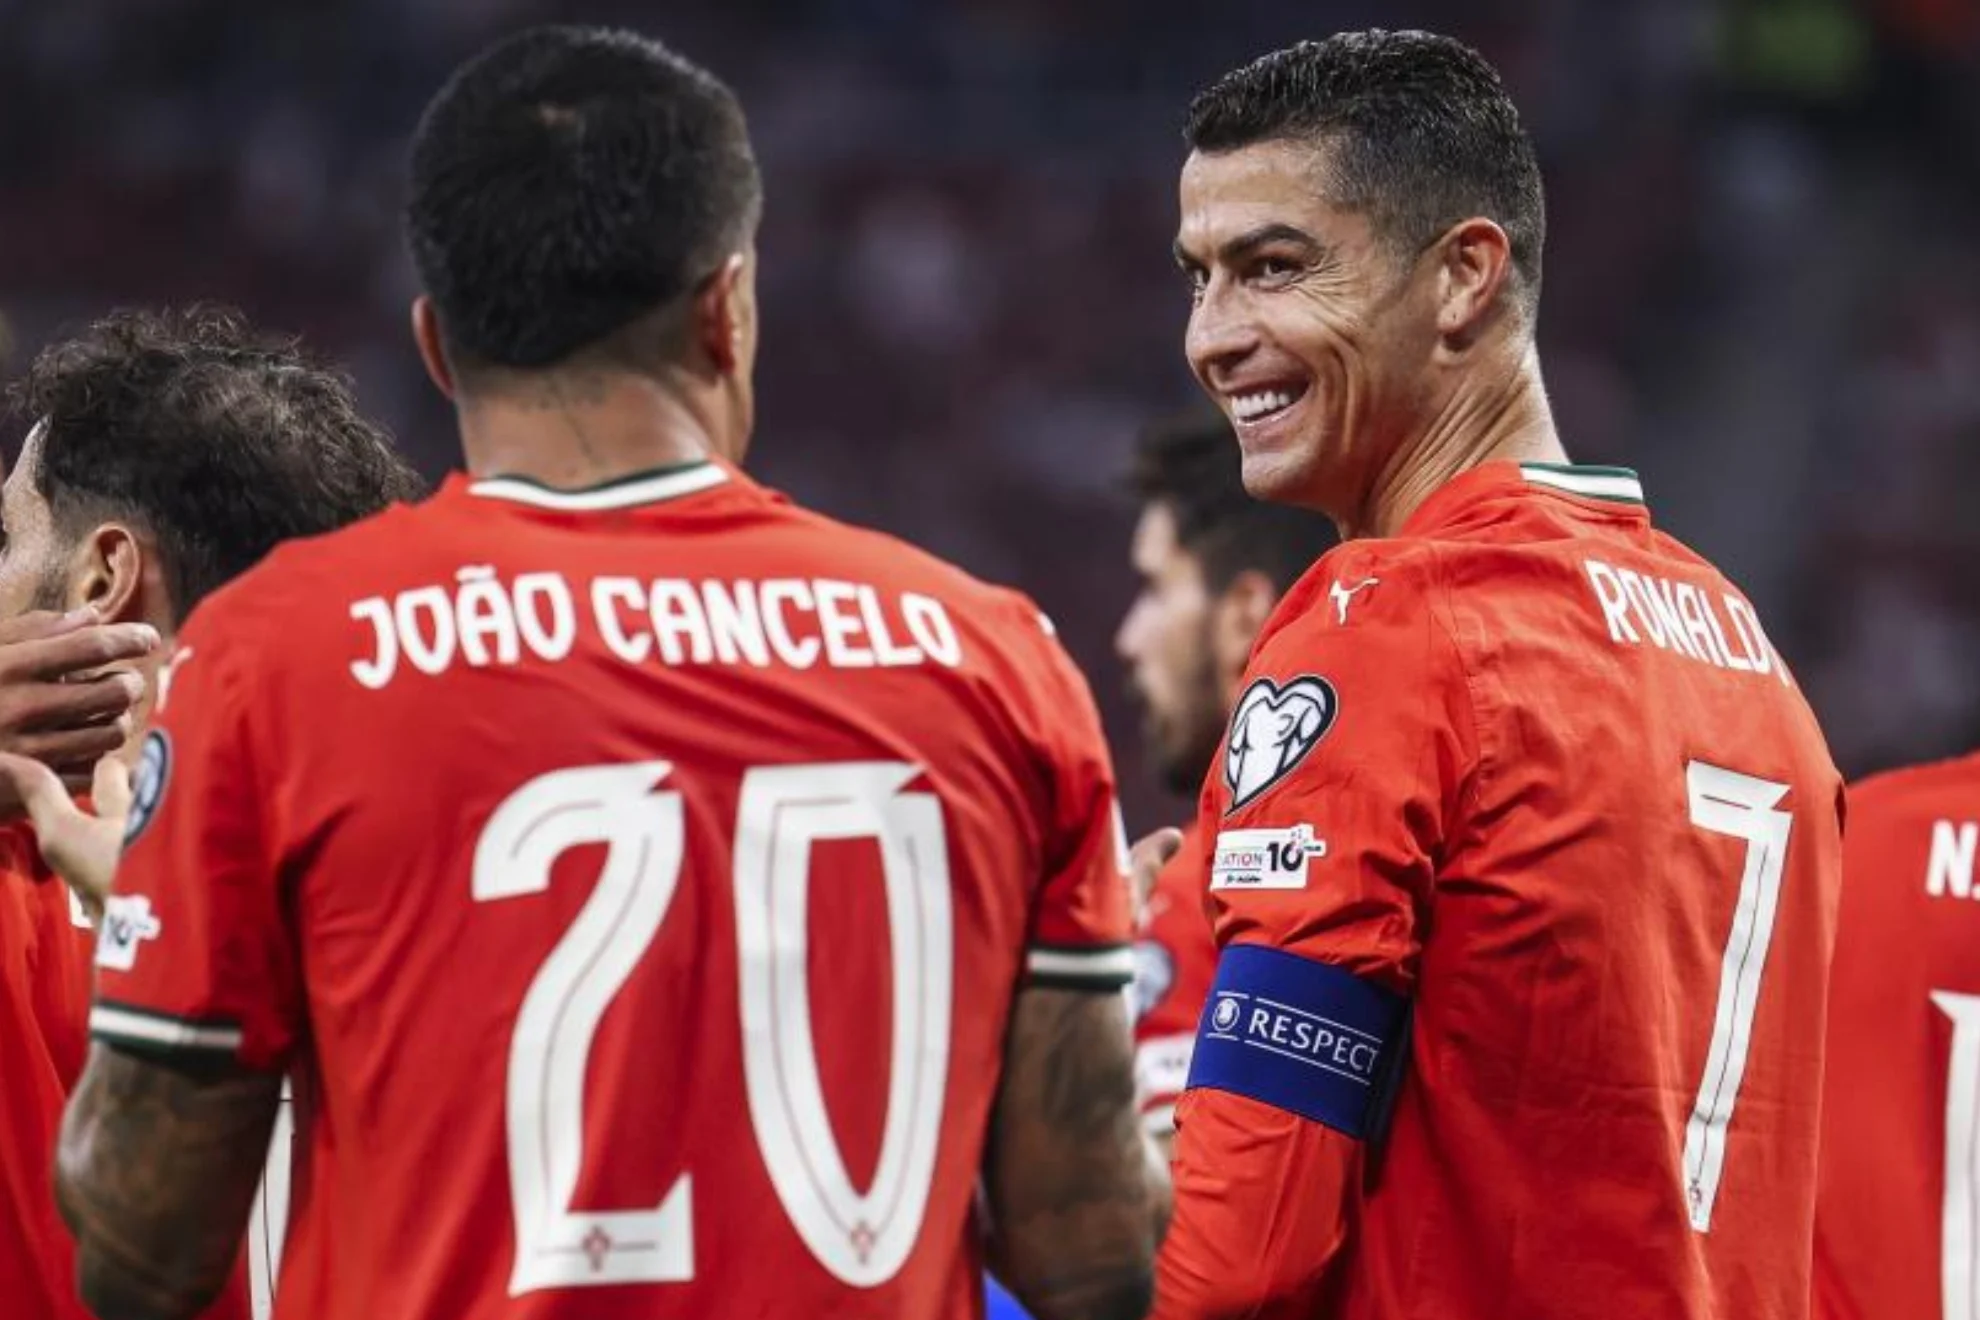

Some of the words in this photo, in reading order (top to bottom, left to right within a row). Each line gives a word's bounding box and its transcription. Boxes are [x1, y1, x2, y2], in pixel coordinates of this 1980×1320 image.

[350, 565, 576, 689] JOÃO
[590, 576, 962, 668] CANCELO
[1584, 559, 1790, 688] RONALD
[1266, 841, 1305, 873] 10
[471, 760, 954, 1298] 20
[1248, 1007, 1379, 1074] RESPECT
[1682, 760, 1794, 1233] 7
